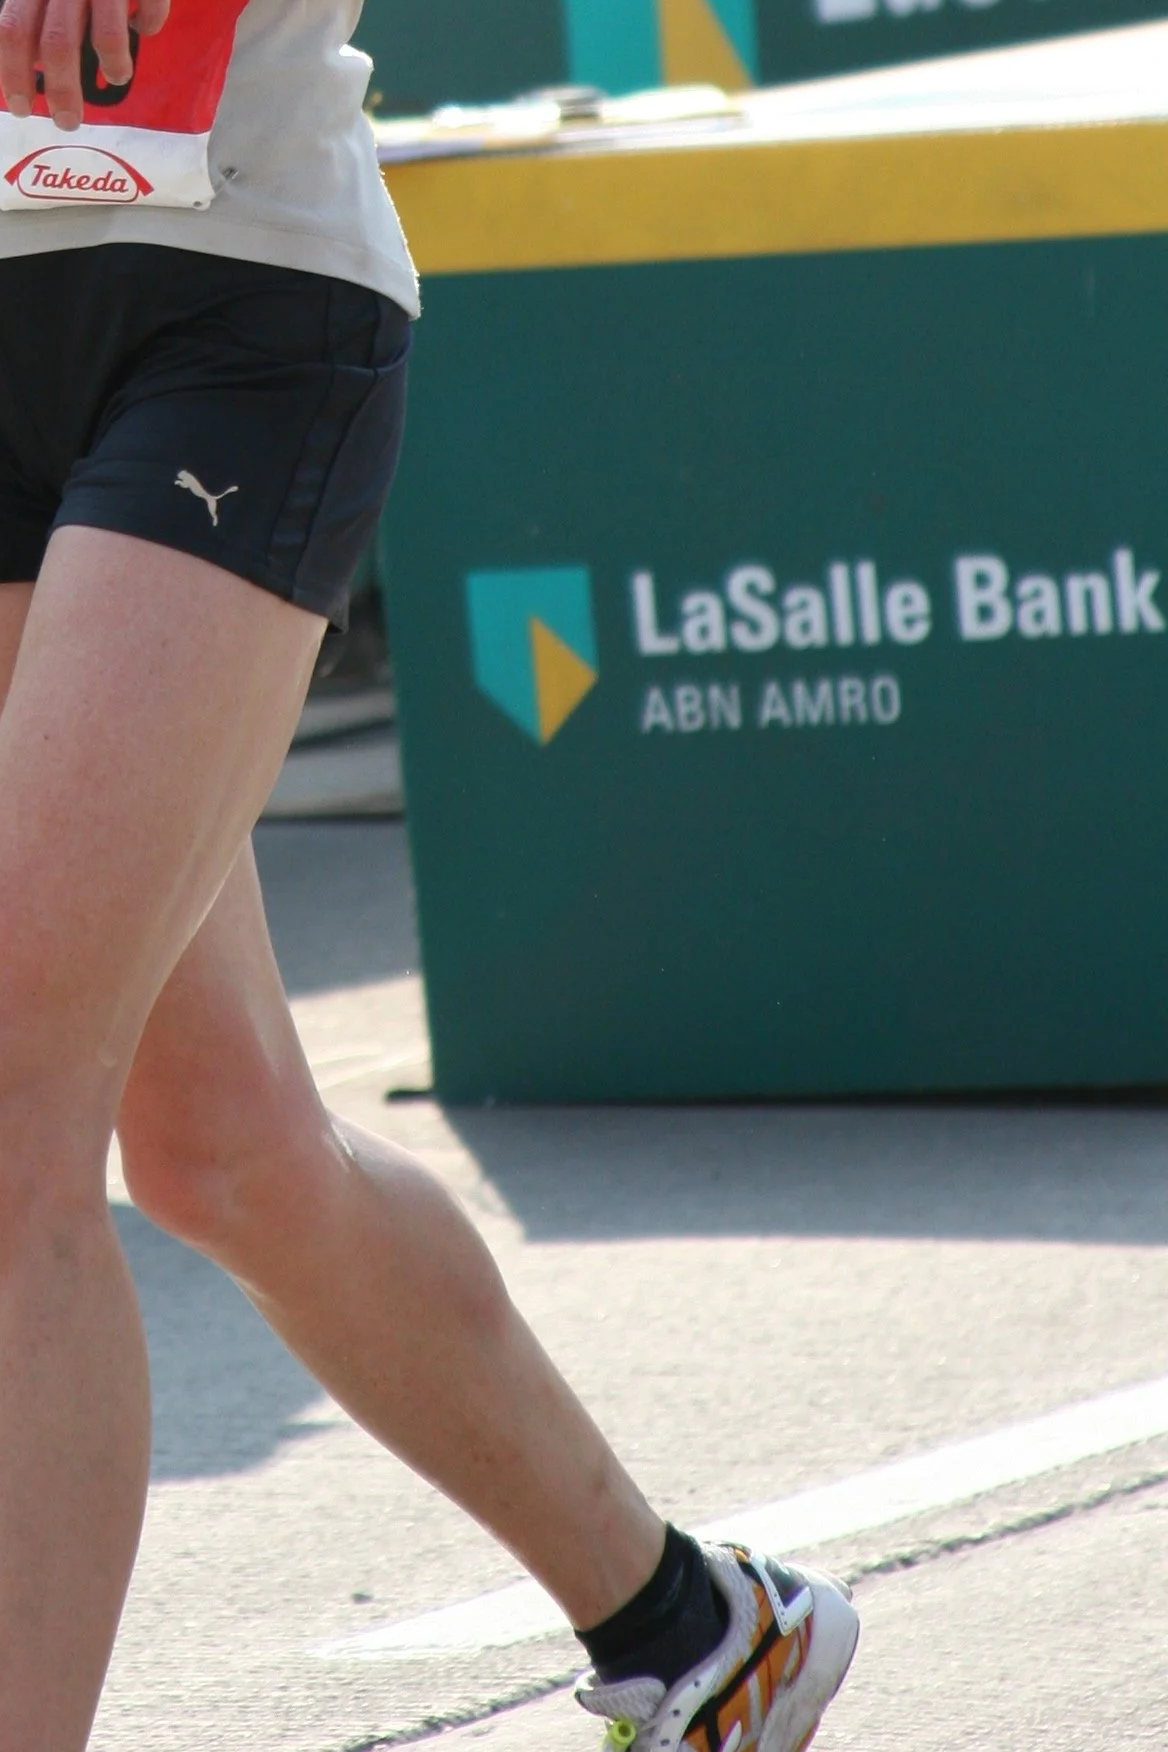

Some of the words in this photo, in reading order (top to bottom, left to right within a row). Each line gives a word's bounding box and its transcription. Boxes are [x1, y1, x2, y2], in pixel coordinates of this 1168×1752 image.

[30, 164, 129, 194] Takeda
[632, 559, 932, 656] LaSalle
[954, 547, 1167, 641] Bank
[642, 680, 742, 733] ABN
[758, 674, 903, 730] AMRO
